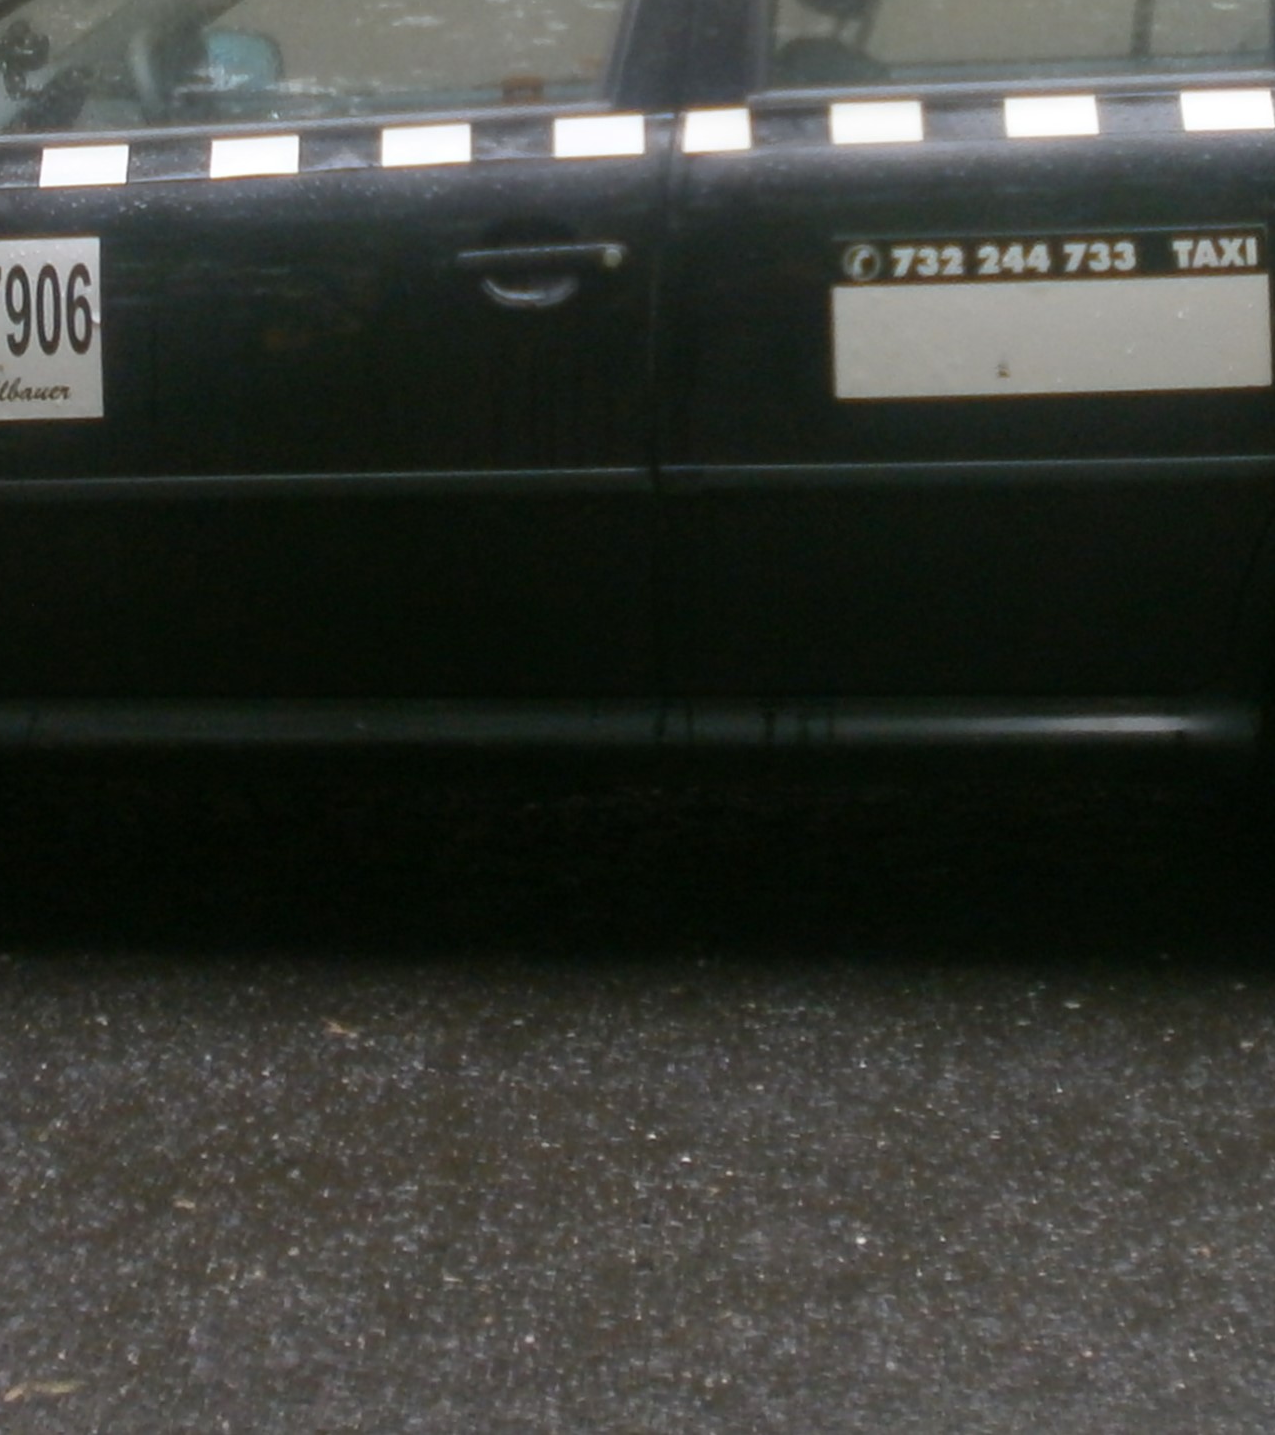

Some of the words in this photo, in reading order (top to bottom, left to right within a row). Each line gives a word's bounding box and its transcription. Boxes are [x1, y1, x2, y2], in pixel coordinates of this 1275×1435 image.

[891, 244, 965, 277] 732
[977, 241, 1052, 274] 244
[1063, 240, 1137, 272] 733
[1172, 236, 1258, 270] TAXI
